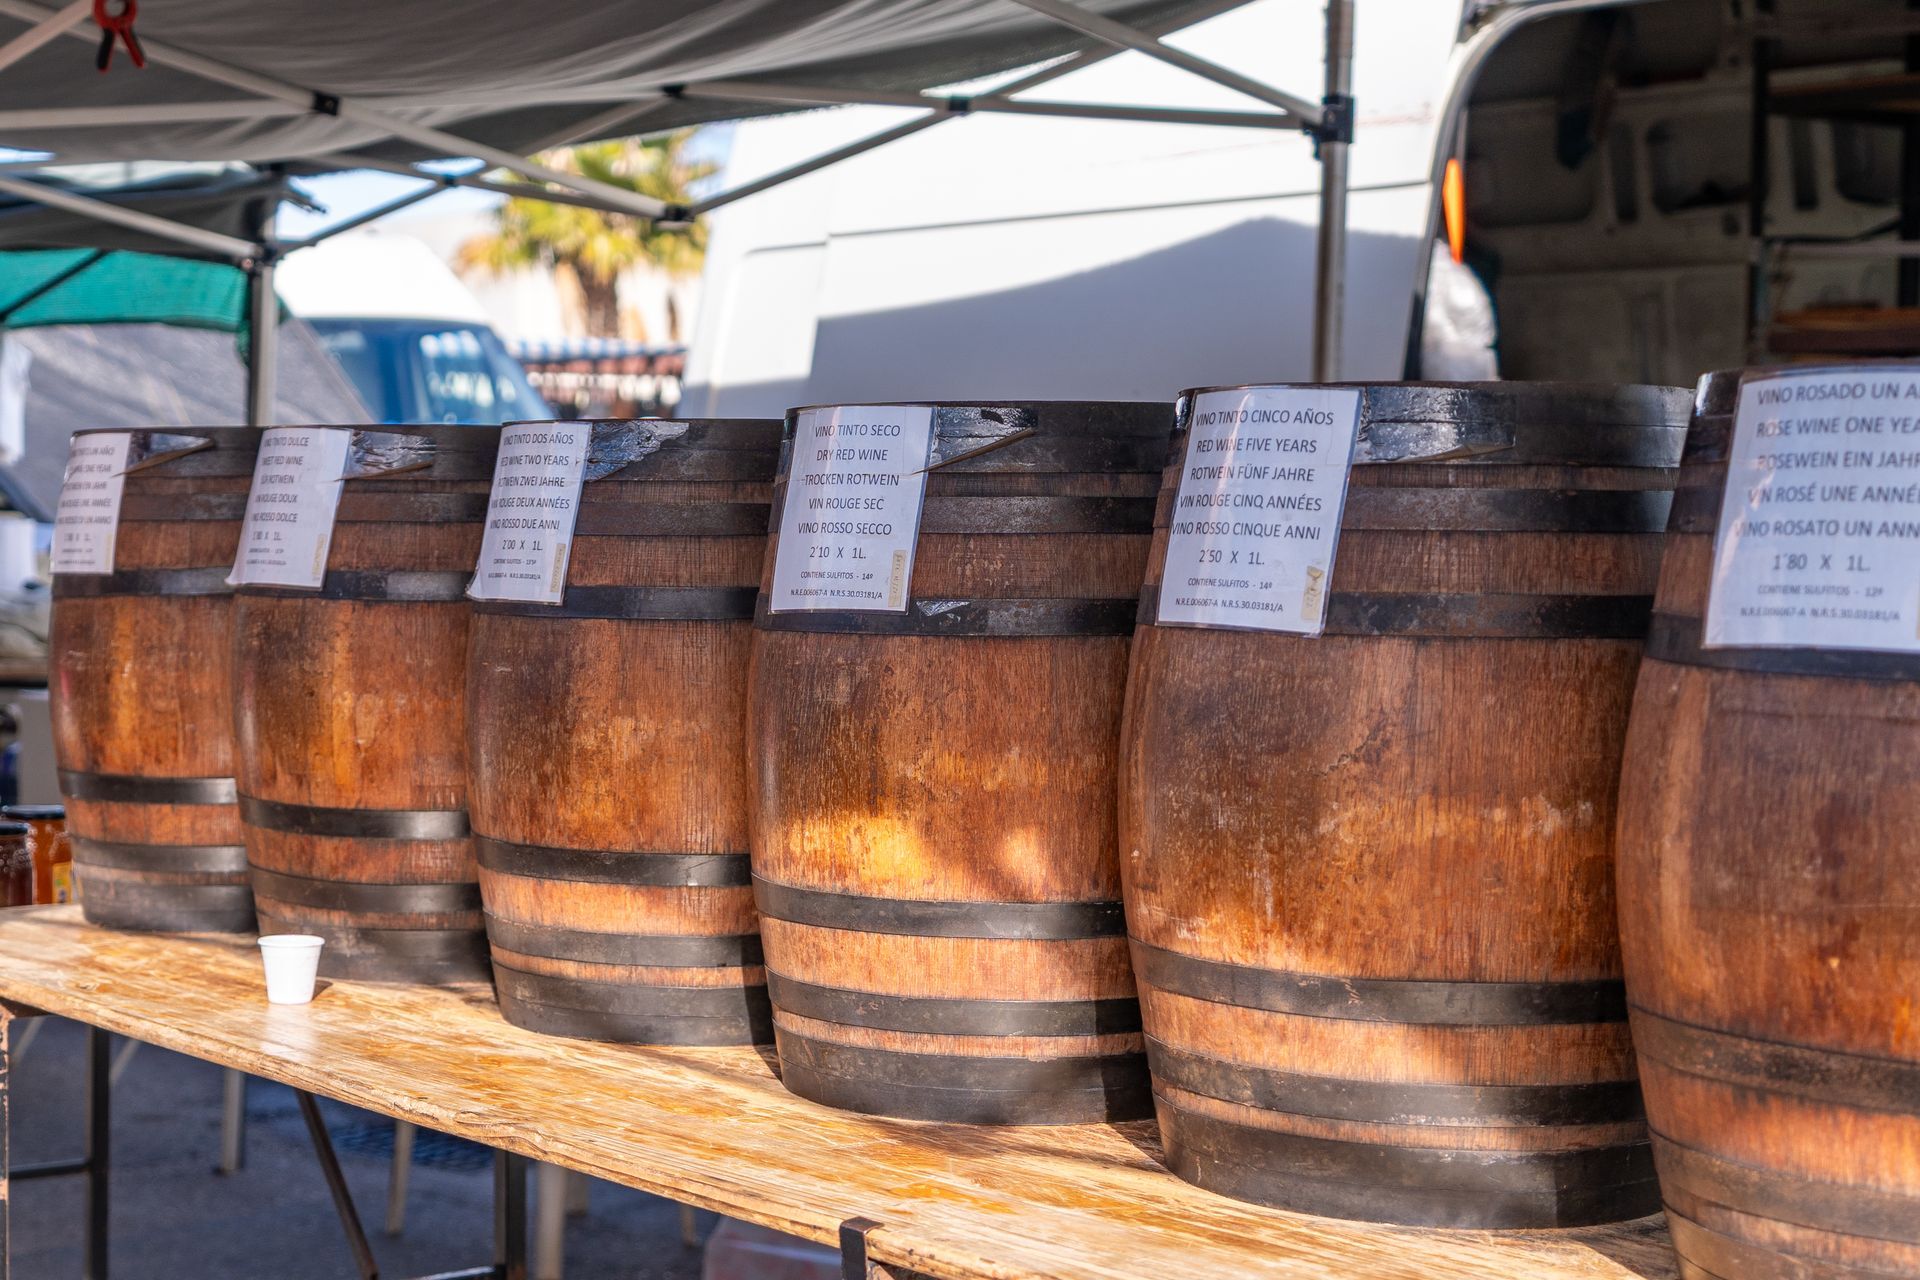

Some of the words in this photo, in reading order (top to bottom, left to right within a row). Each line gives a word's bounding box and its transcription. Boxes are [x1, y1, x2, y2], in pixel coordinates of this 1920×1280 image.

[1757, 387, 1792, 405] VINO
[1796, 383, 1866, 400] ROSADO
[1871, 383, 1899, 399] UN
[1904, 383, 1920, 399] A
[1196, 412, 1216, 426] VINO
[1218, 411, 1248, 424] TINTO
[1251, 409, 1290, 424] CINCO
[1293, 408, 1334, 425] AÑOS
[815, 426, 835, 437] VINO
[838, 424, 868, 436] TINTO
[870, 424, 900, 436] SECO
[1757, 420, 1792, 438] ROSE
[1796, 417, 1840, 435] WINE
[1845, 417, 1883, 433] ONE
[288, 437, 309, 446] DULCE
[514, 434, 530, 445] TINTO
[532, 434, 547, 444] DOS
[549, 432, 574, 444] AÑOS
[1196, 440, 1213, 453] RED
[1216, 438, 1244, 451] WINE
[1246, 438, 1272, 451] FIVE
[1275, 439, 1317, 453] YEARS
[286, 456, 304, 465] WINE
[509, 456, 523, 465] WINE
[525, 455, 541, 465] TWO
[544, 455, 569, 465] YEARS
[817, 450, 832, 461] DRY
[836, 449, 855, 460] RED
[858, 449, 888, 460] WINE
[1758, 451, 1837, 470] ROSEWEIN
[1843, 451, 1872, 468] EIN
[1190, 466, 1234, 480] ROTWEIN
[1237, 463, 1269, 479] FÜNF
[1271, 466, 1315, 482] JAHRE
[520, 476, 538, 486] ZWEI
[539, 477, 565, 487] JAHRE
[805, 474, 844, 486] TROCKEN
[846, 474, 899, 486] ROTWEIN
[278, 493, 298, 503] DOUX
[1747, 488, 1771, 503] VIN
[1776, 482, 1816, 502] ROSÉ
[1820, 486, 1858, 502] UNE
[499, 498, 516, 508] ROUGE
[516, 497, 535, 507] DEUX
[536, 496, 570, 509] ANNÉES
[809, 498, 823, 510] VIN
[826, 498, 860, 509] ROUGE
[864, 498, 884, 510] SEC
[1180, 496, 1194, 508] VIN
[1196, 494, 1231, 507] ROUGE
[1233, 494, 1264, 509] CINQ
[1266, 494, 1322, 511] ANNÉES
[276, 512, 298, 522] DOLCE
[491, 519, 501, 529] VINO
[502, 519, 520, 528] ROSSO
[522, 519, 537, 529] DUE
[538, 520, 560, 530] ANNI
[798, 522, 818, 534] VINO
[821, 522, 853, 534] ROSSO
[856, 523, 892, 535] SECCO
[1172, 523, 1194, 535] VINO
[1196, 522, 1230, 535] ROSSO
[1233, 522, 1281, 538] CINQUE
[1284, 525, 1320, 540] ANNI
[1734, 522, 1769, 538] VINO
[1774, 520, 1840, 537] ROSATO
[1844, 521, 1872, 537] UN
[520, 540, 525, 550] X
[836, 547, 843, 558] X
[852, 547, 866, 559] 1L.
[1230, 551, 1238, 564] X
[1248, 552, 1265, 565] 1L.
[1819, 555, 1832, 570] X
[1847, 555, 1871, 572] 1L.
[1188, 578, 1217, 586] CONTIENE
[1218, 578, 1249, 588] SULFITOS
[1757, 585, 1801, 595] CONTIENE
[1804, 585, 1851, 595] SULFITOS
[1221, 600, 1284, 613] N.R.S.30.03181/A
